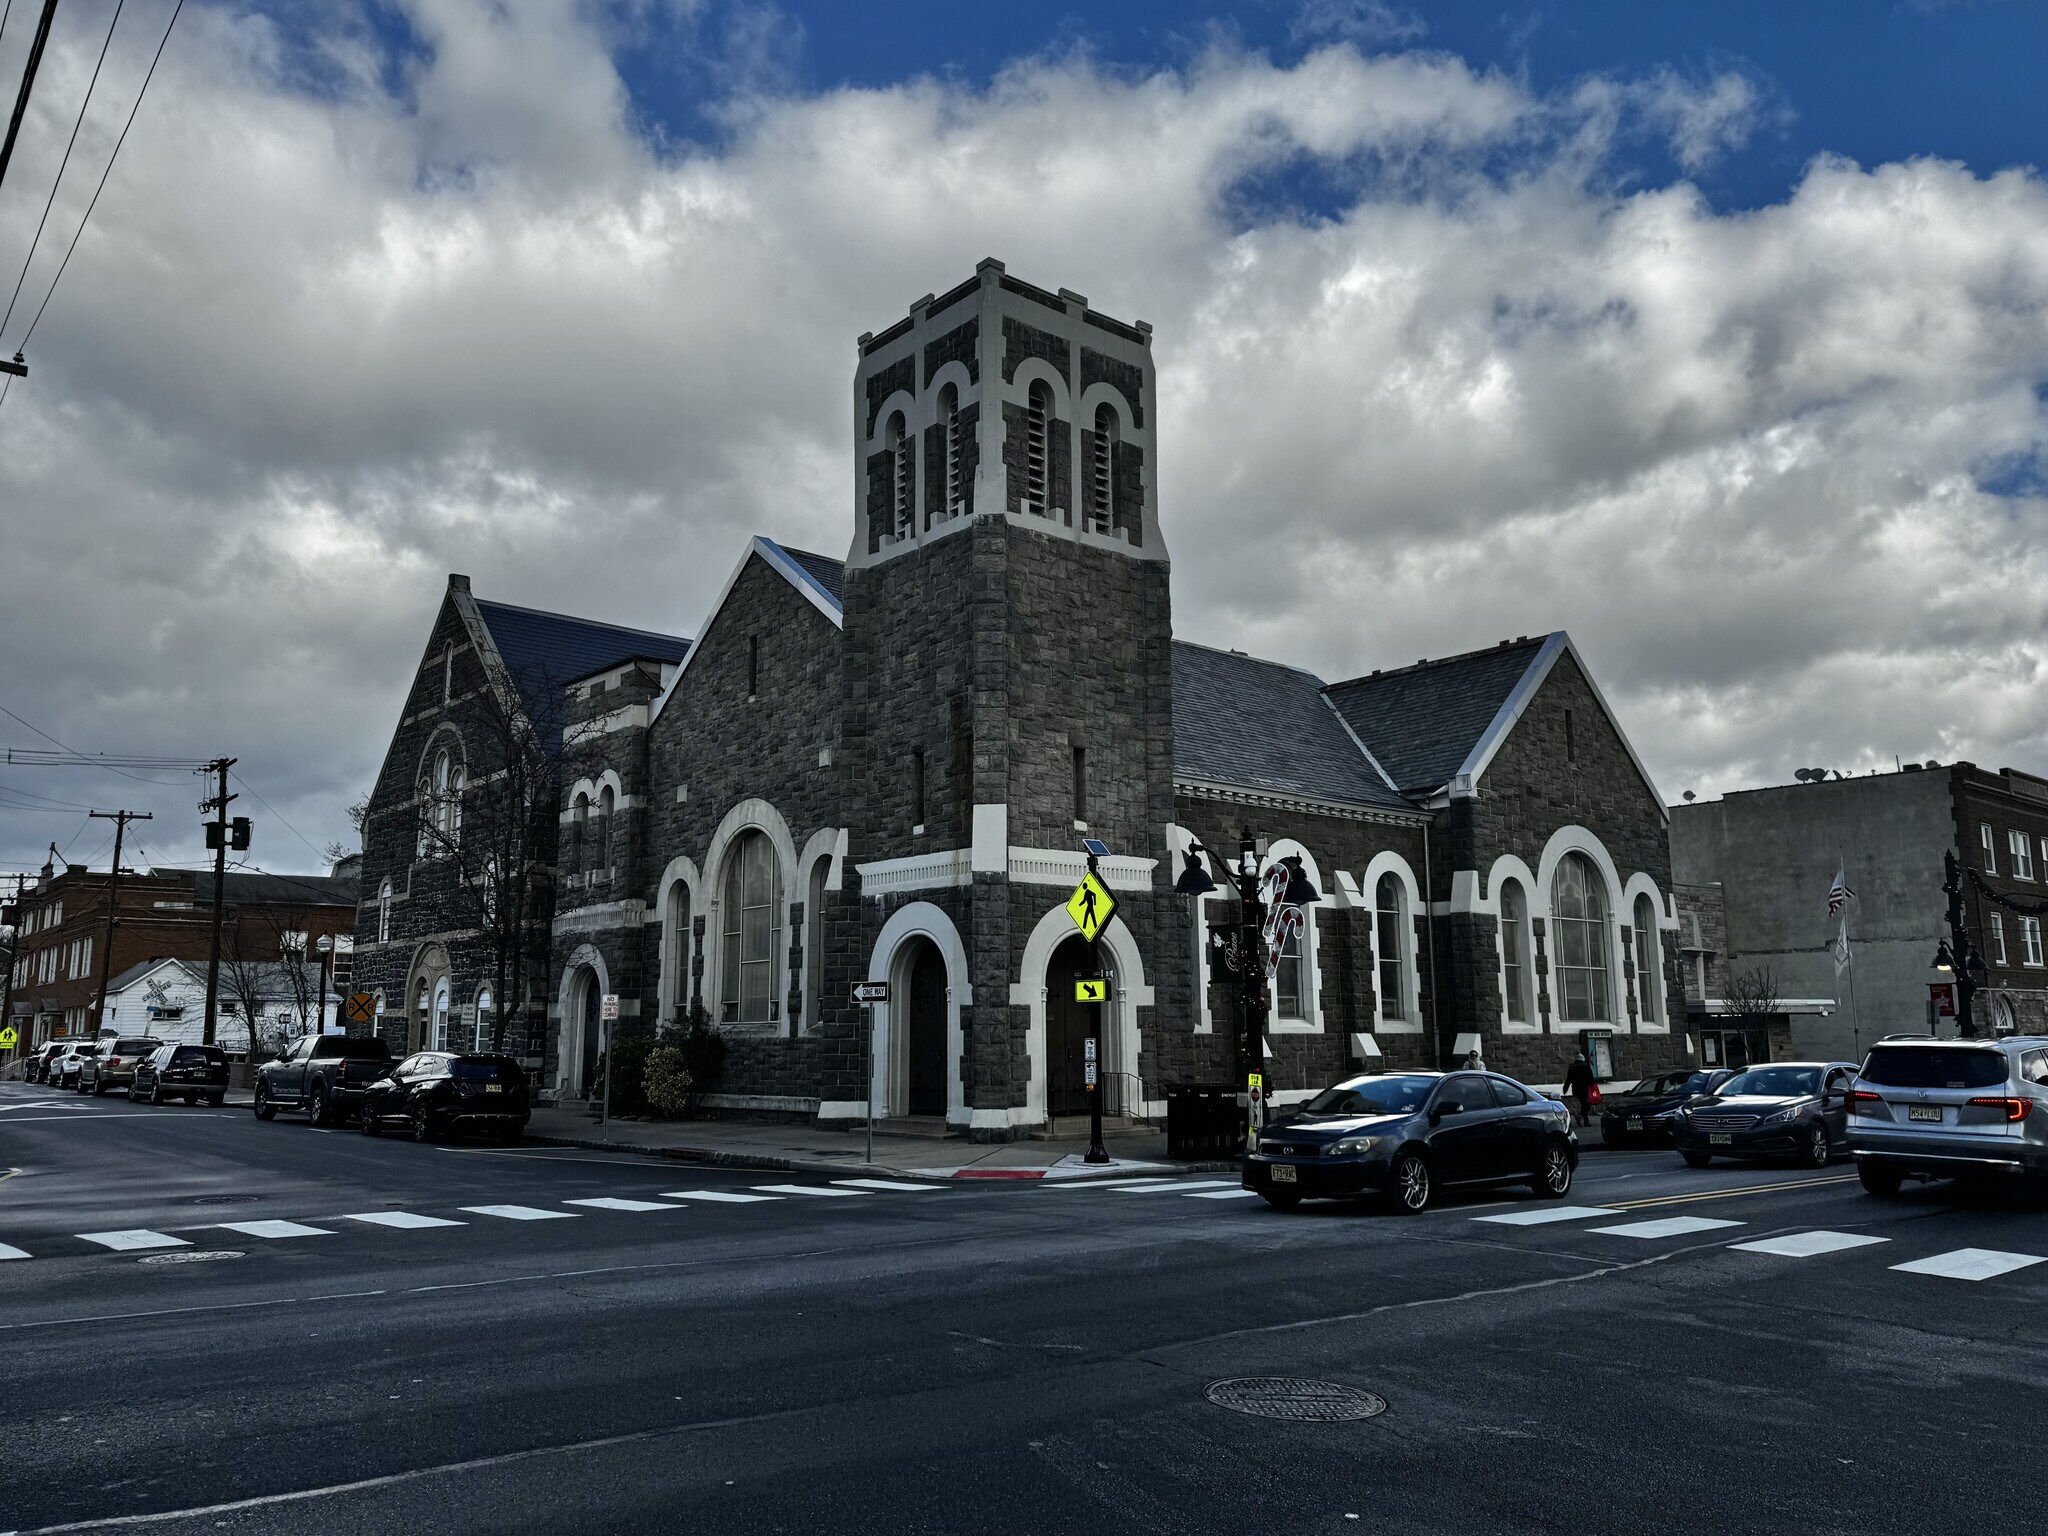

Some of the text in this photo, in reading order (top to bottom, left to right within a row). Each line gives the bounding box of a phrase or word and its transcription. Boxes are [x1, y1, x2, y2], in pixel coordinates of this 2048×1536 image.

[1224, 932, 1240, 972] Peace
[862, 988, 885, 996] ONE WAY
